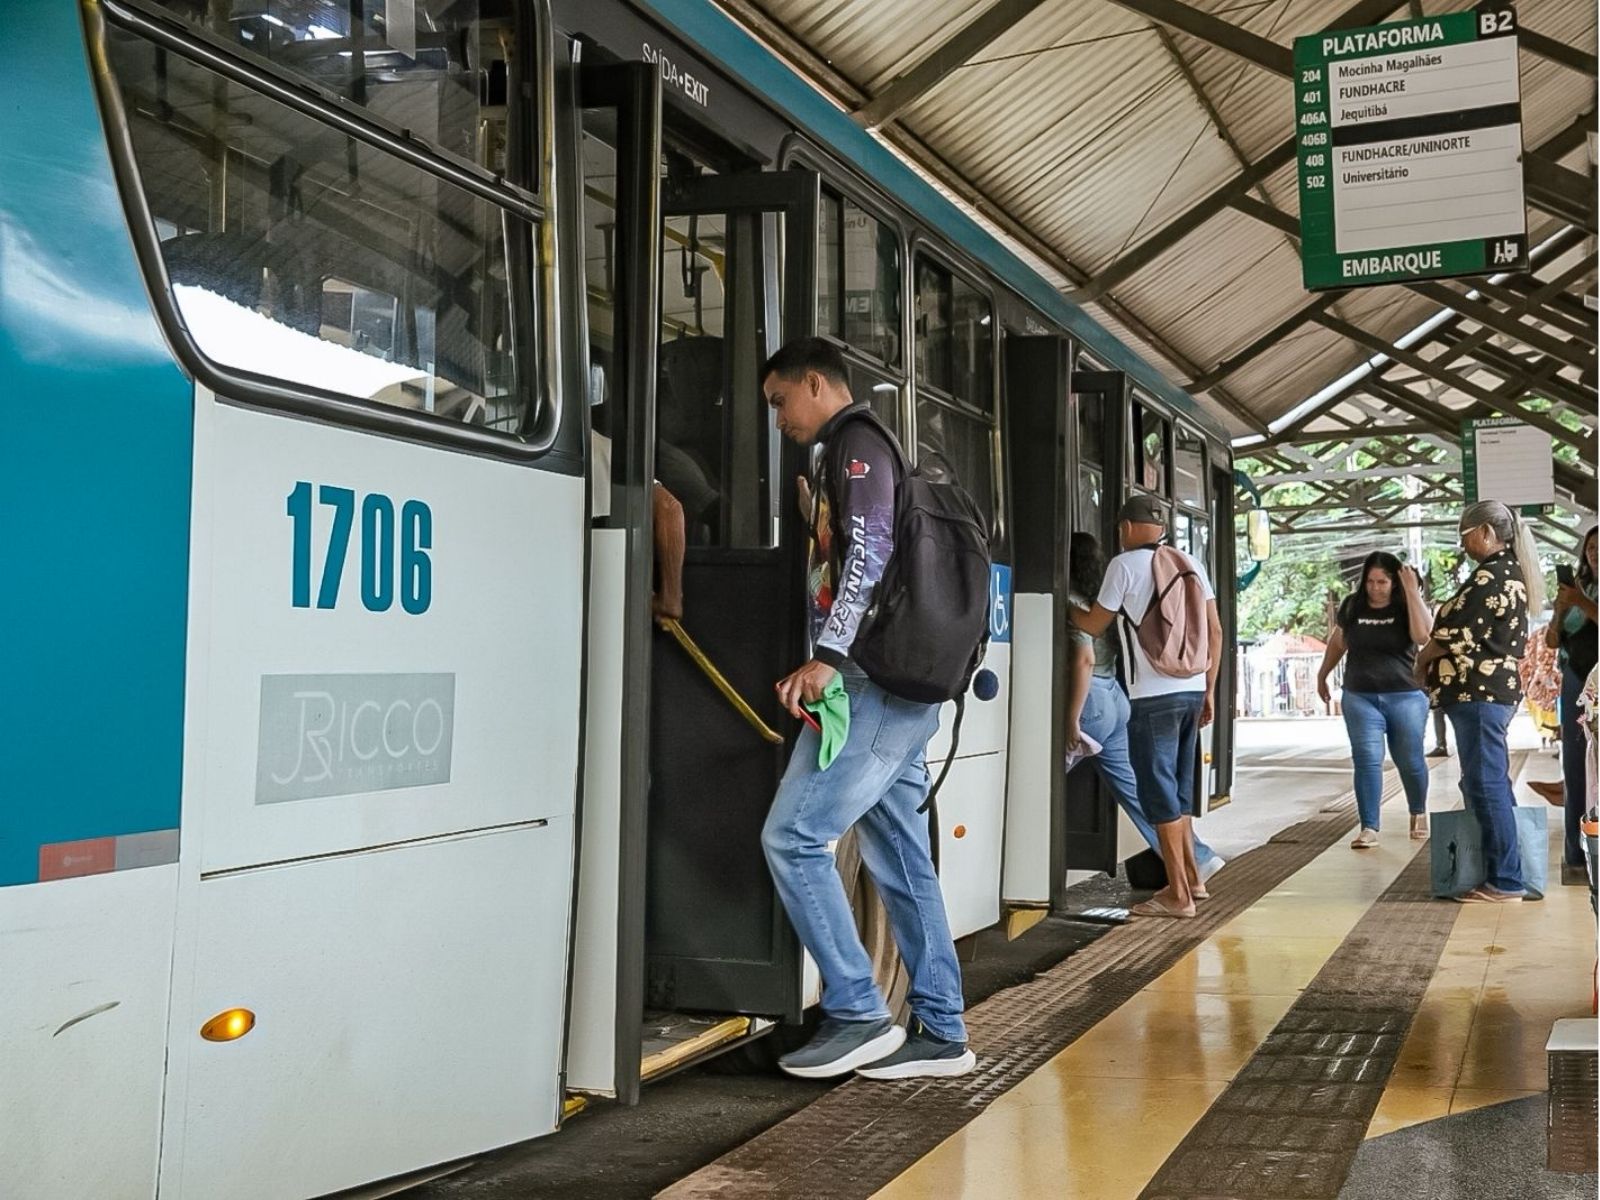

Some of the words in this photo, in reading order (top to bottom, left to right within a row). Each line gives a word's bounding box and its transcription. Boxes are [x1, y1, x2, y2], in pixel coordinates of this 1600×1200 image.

[1480, 10, 1514, 35] B2
[1322, 22, 1444, 56] PLATAFORMA
[1302, 69, 1321, 84] 204
[1338, 62, 1383, 79] Mocinha
[1386, 54, 1443, 73] Magalhães
[1302, 89, 1321, 104] 401
[1339, 79, 1406, 100] FUNDHACRE
[1300, 111, 1328, 126] 406A
[1340, 103, 1388, 122] Jequitibá
[1301, 132, 1328, 147] 406B
[1341, 136, 1471, 164] FUNDHACRE/UNINORTE
[1304, 153, 1326, 168] 408
[1306, 175, 1326, 189] 502
[1342, 166, 1410, 185] Universitário
[1342, 250, 1443, 279] EMBARQUE
[286, 480, 433, 616] 1706
[829, 514, 865, 638] TUCUNARÉ
